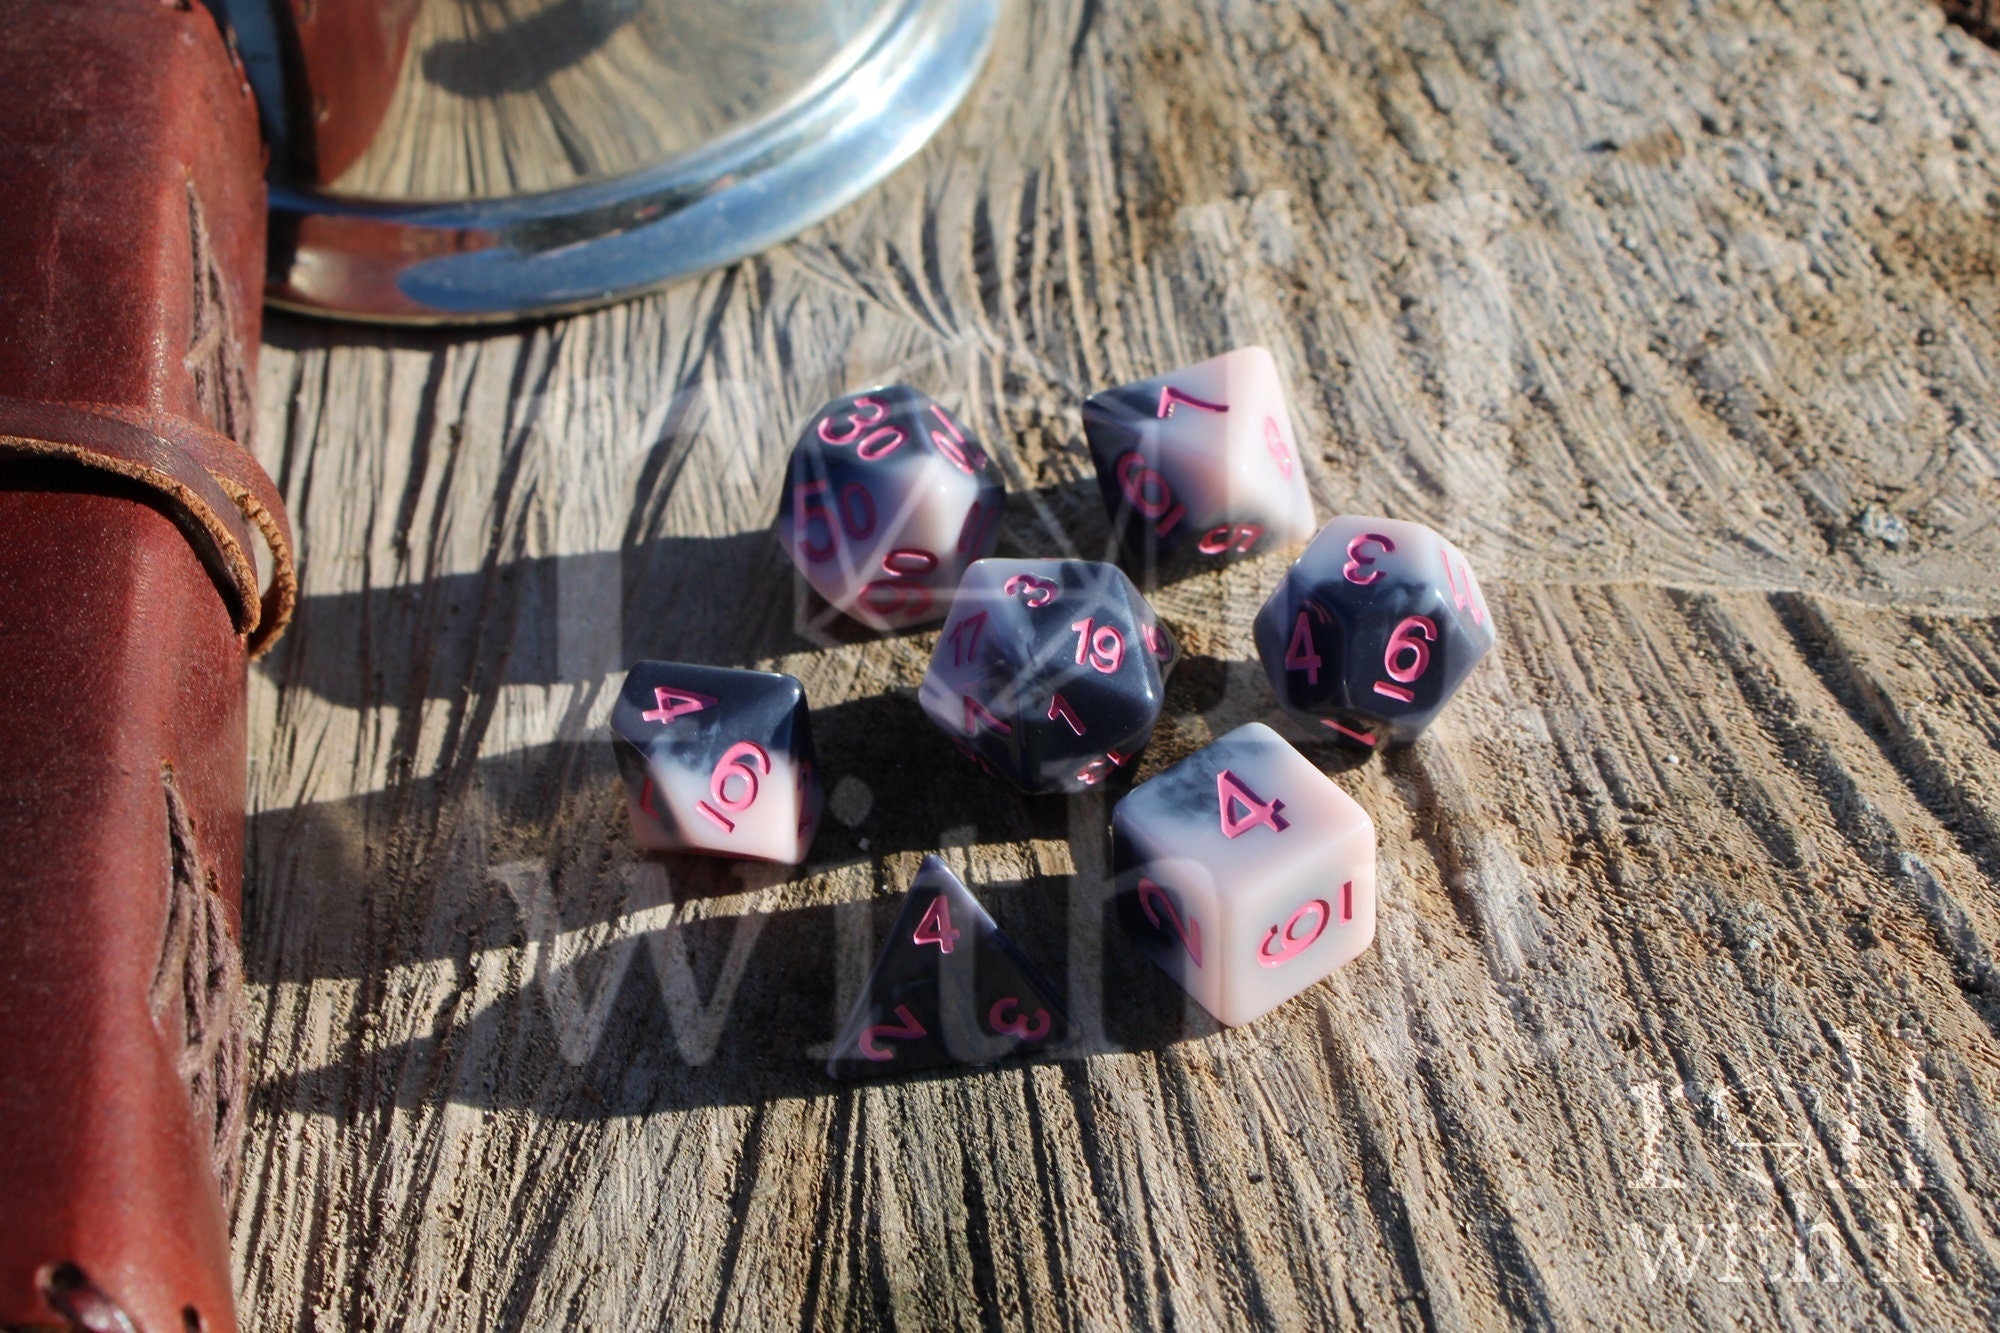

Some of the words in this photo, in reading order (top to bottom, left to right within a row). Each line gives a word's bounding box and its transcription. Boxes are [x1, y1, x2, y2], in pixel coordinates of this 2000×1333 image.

[817, 397, 908, 461] 30
[1155, 386, 1230, 419] 7
[793, 479, 877, 563] 50
[1116, 452, 1188, 538] 6
[1198, 523, 1266, 555] 5
[1343, 533, 1396, 585] 3
[1004, 574, 1058, 608] 3
[948, 611, 988, 667] 17
[1071, 616, 1126, 675] 19
[1285, 611, 1322, 685] 4
[1373, 614, 1438, 703] 6
[642, 686, 718, 724] 4
[1047, 691, 1087, 736] 1
[694, 740, 771, 834] 6
[1216, 769, 1291, 839] 4
[913, 894, 961, 955] 4
[1137, 877, 1203, 968] 2
[1257, 880, 1353, 968] 6
[858, 1003, 928, 1062] 2
[988, 996, 1052, 1042] 3
